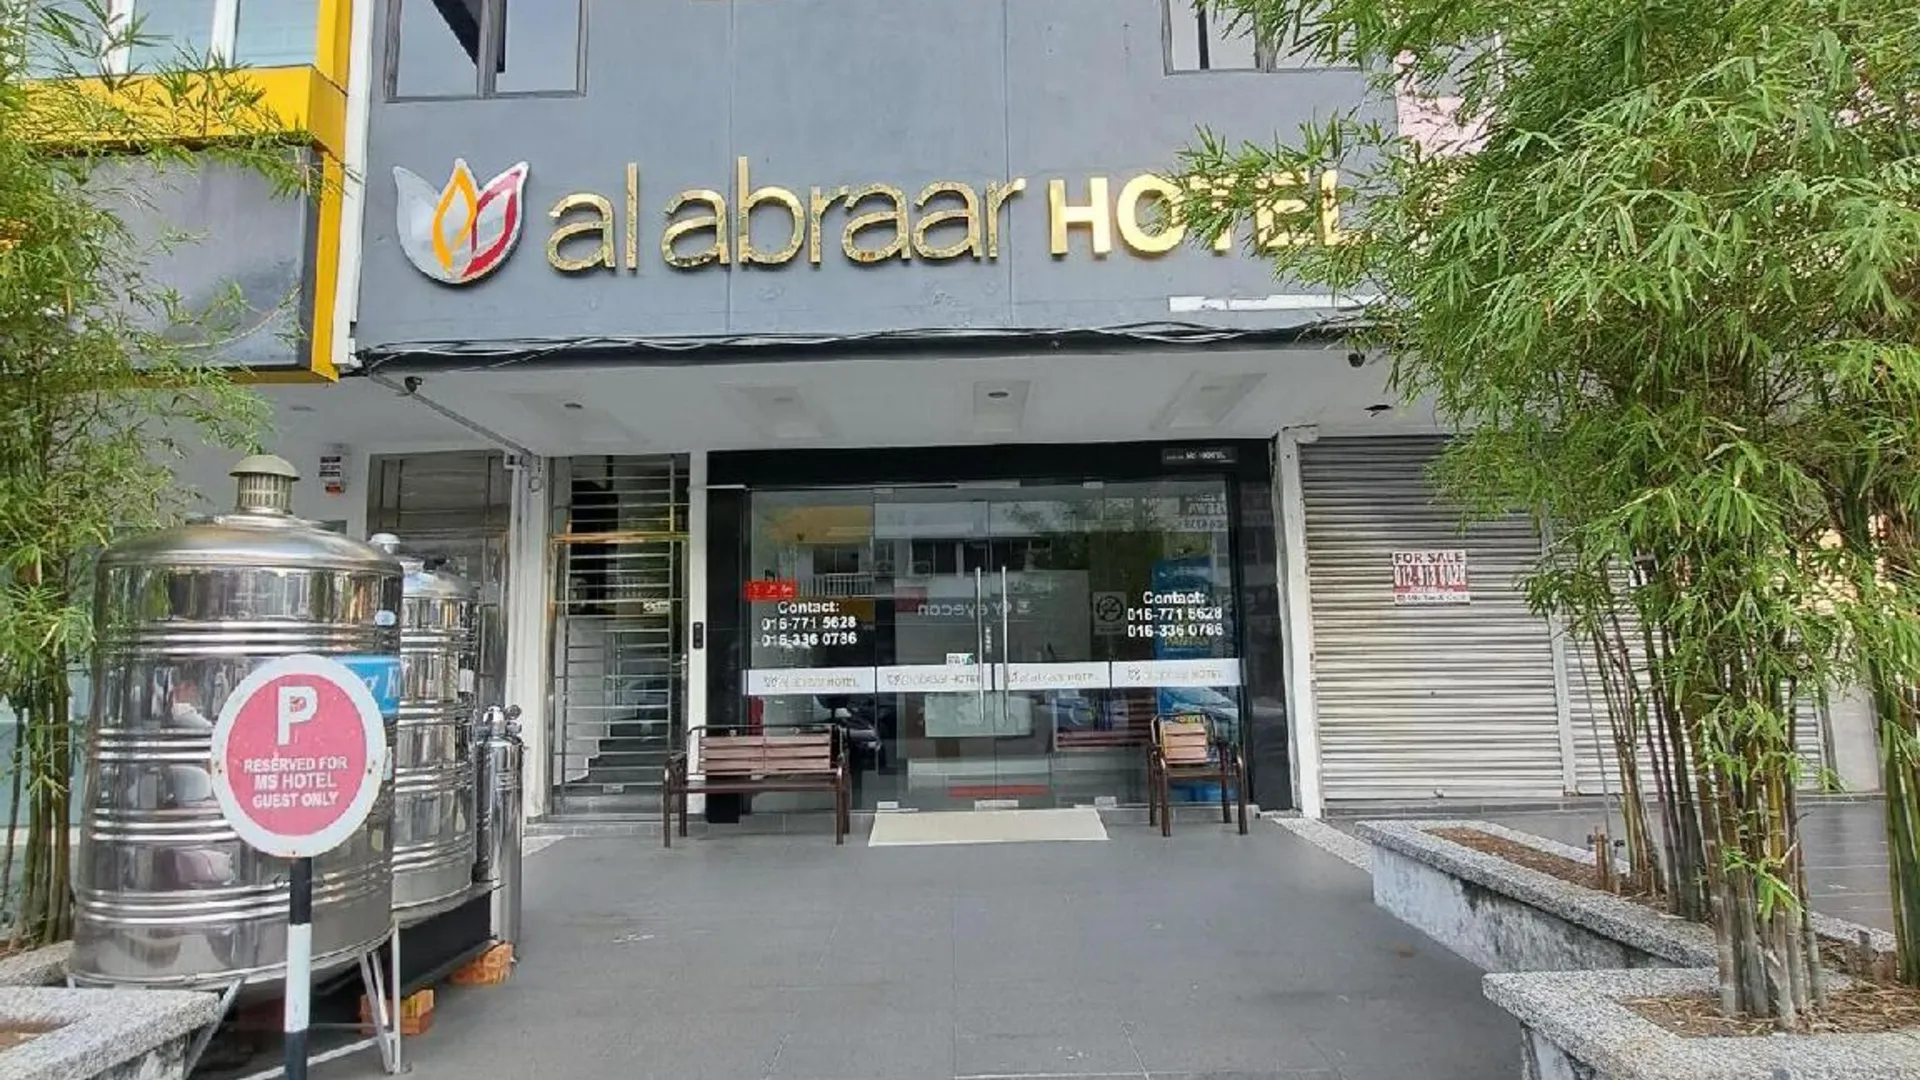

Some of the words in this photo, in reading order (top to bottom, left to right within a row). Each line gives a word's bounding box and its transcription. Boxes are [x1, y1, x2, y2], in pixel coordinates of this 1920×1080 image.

[546, 162, 639, 272] al
[660, 156, 1028, 271] abraar
[1394, 552, 1423, 564] FOR
[1428, 552, 1464, 563] SALE
[1143, 591, 1205, 605] Contact:
[777, 601, 840, 614] Contact:
[277, 686, 319, 746] P
[244, 757, 316, 774] RESERVED
[319, 756, 348, 770] FOR
[254, 774, 279, 790] MS
[282, 772, 338, 788] HOTEL
[252, 792, 298, 808] GUEST
[301, 791, 339, 807] ONLY
